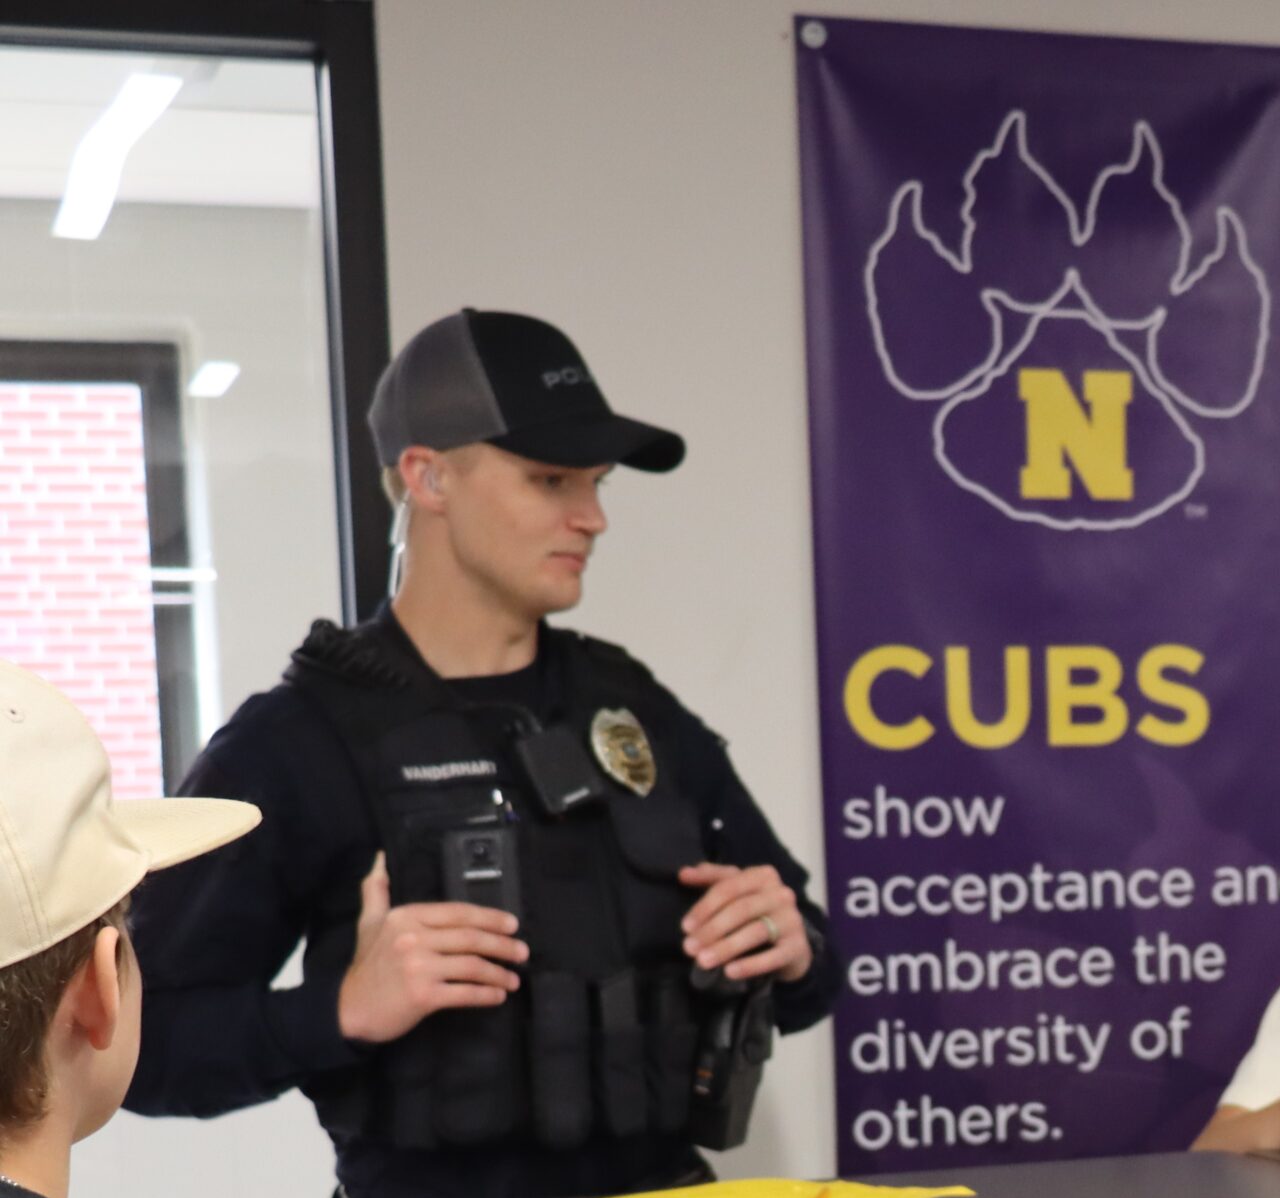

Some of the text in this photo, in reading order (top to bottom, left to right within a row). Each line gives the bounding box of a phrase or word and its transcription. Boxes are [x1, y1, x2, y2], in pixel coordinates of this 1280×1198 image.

[1018, 368, 1135, 501] N
[843, 644, 1210, 751] CUBS
[843, 784, 1005, 839] show
[845, 862, 1195, 922] acceptance
[847, 931, 1226, 995] embrace the
[850, 1005, 1191, 1073] diversity of
[853, 1094, 1063, 1151] others.
